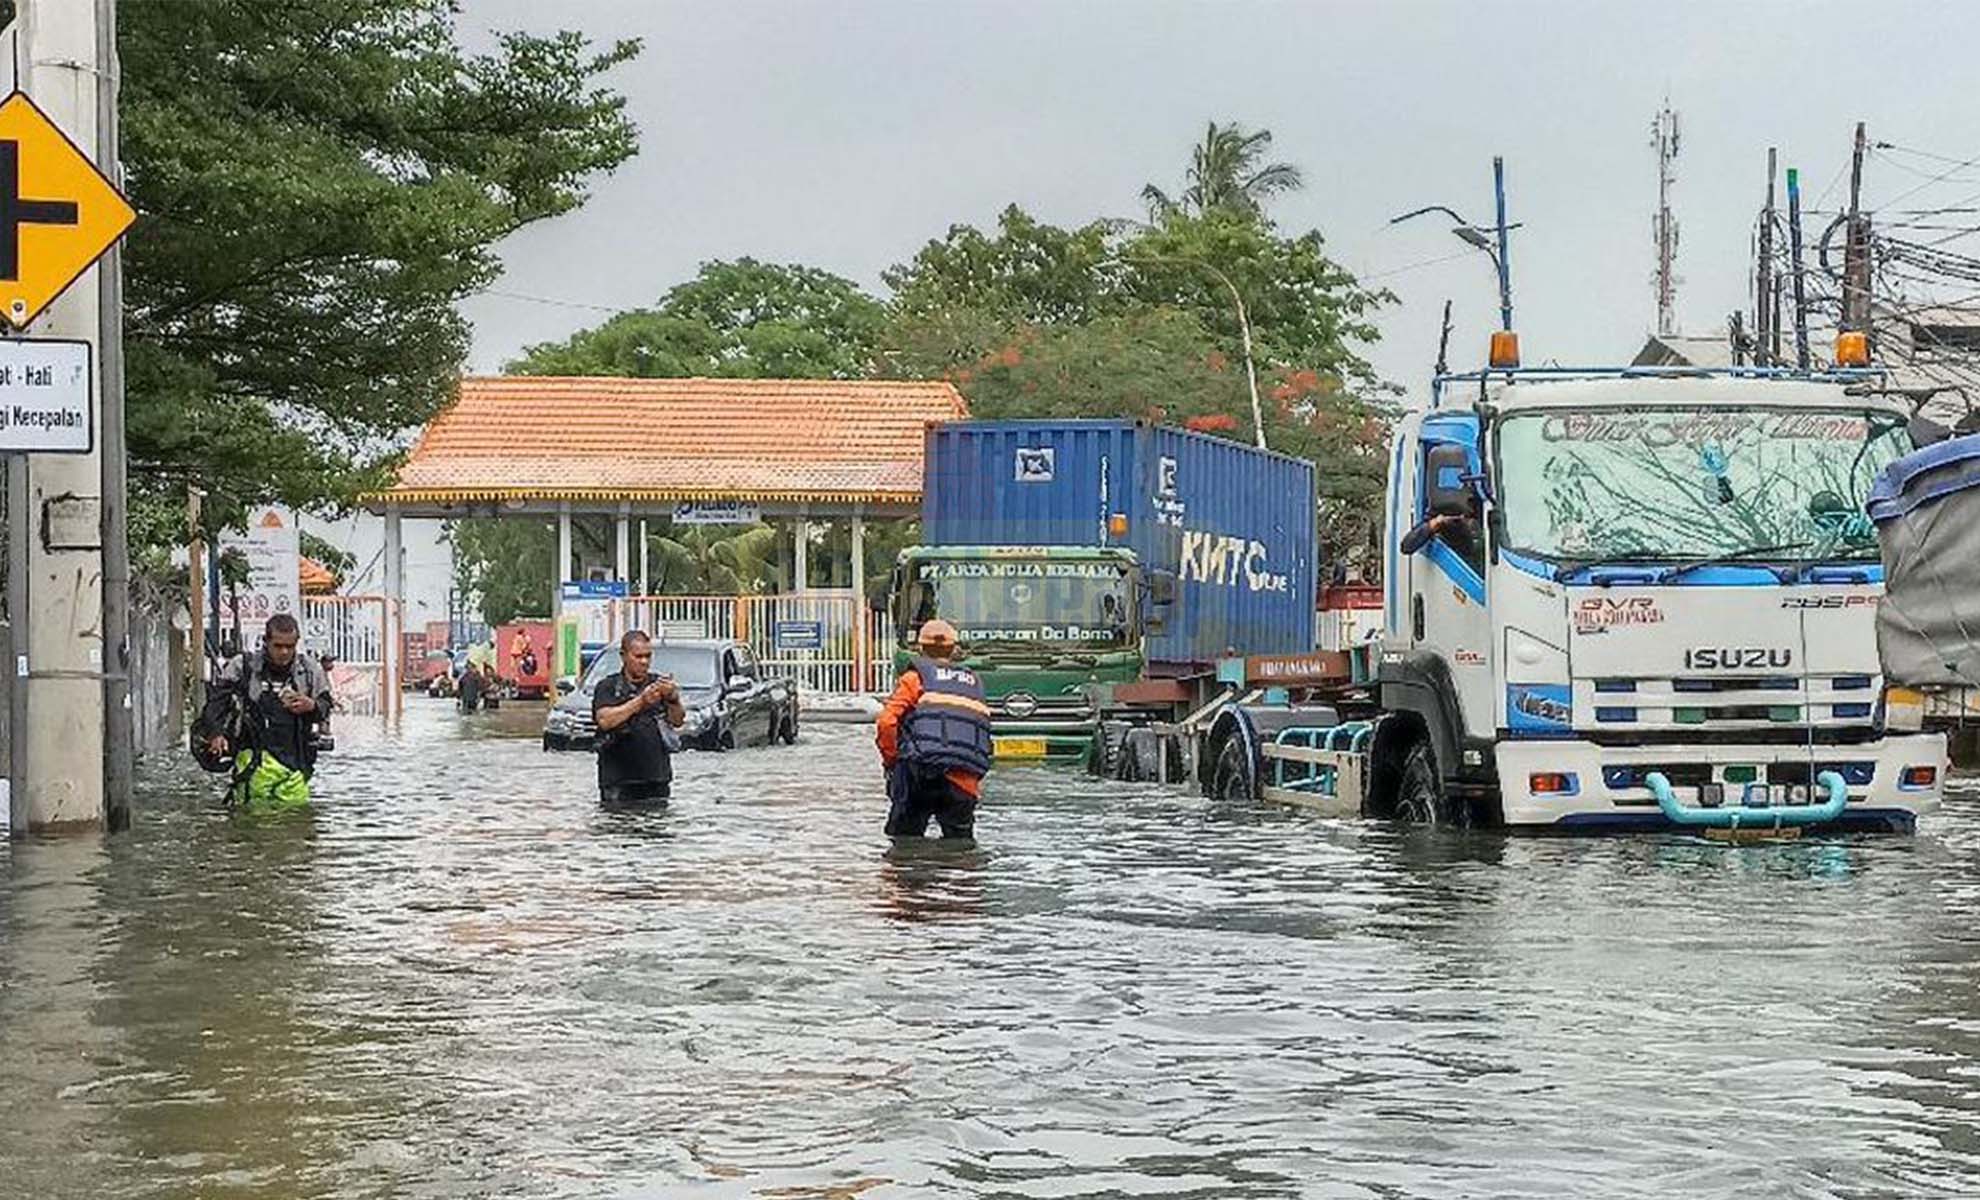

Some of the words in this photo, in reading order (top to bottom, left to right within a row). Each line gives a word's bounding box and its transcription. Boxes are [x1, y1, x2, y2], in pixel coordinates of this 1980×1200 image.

[26, 365, 52, 386] Hati
[13, 405, 83, 431] Kecepatan
[1046, 564, 1121, 579] BERSAMA
[1685, 648, 1792, 669] ISUZU
